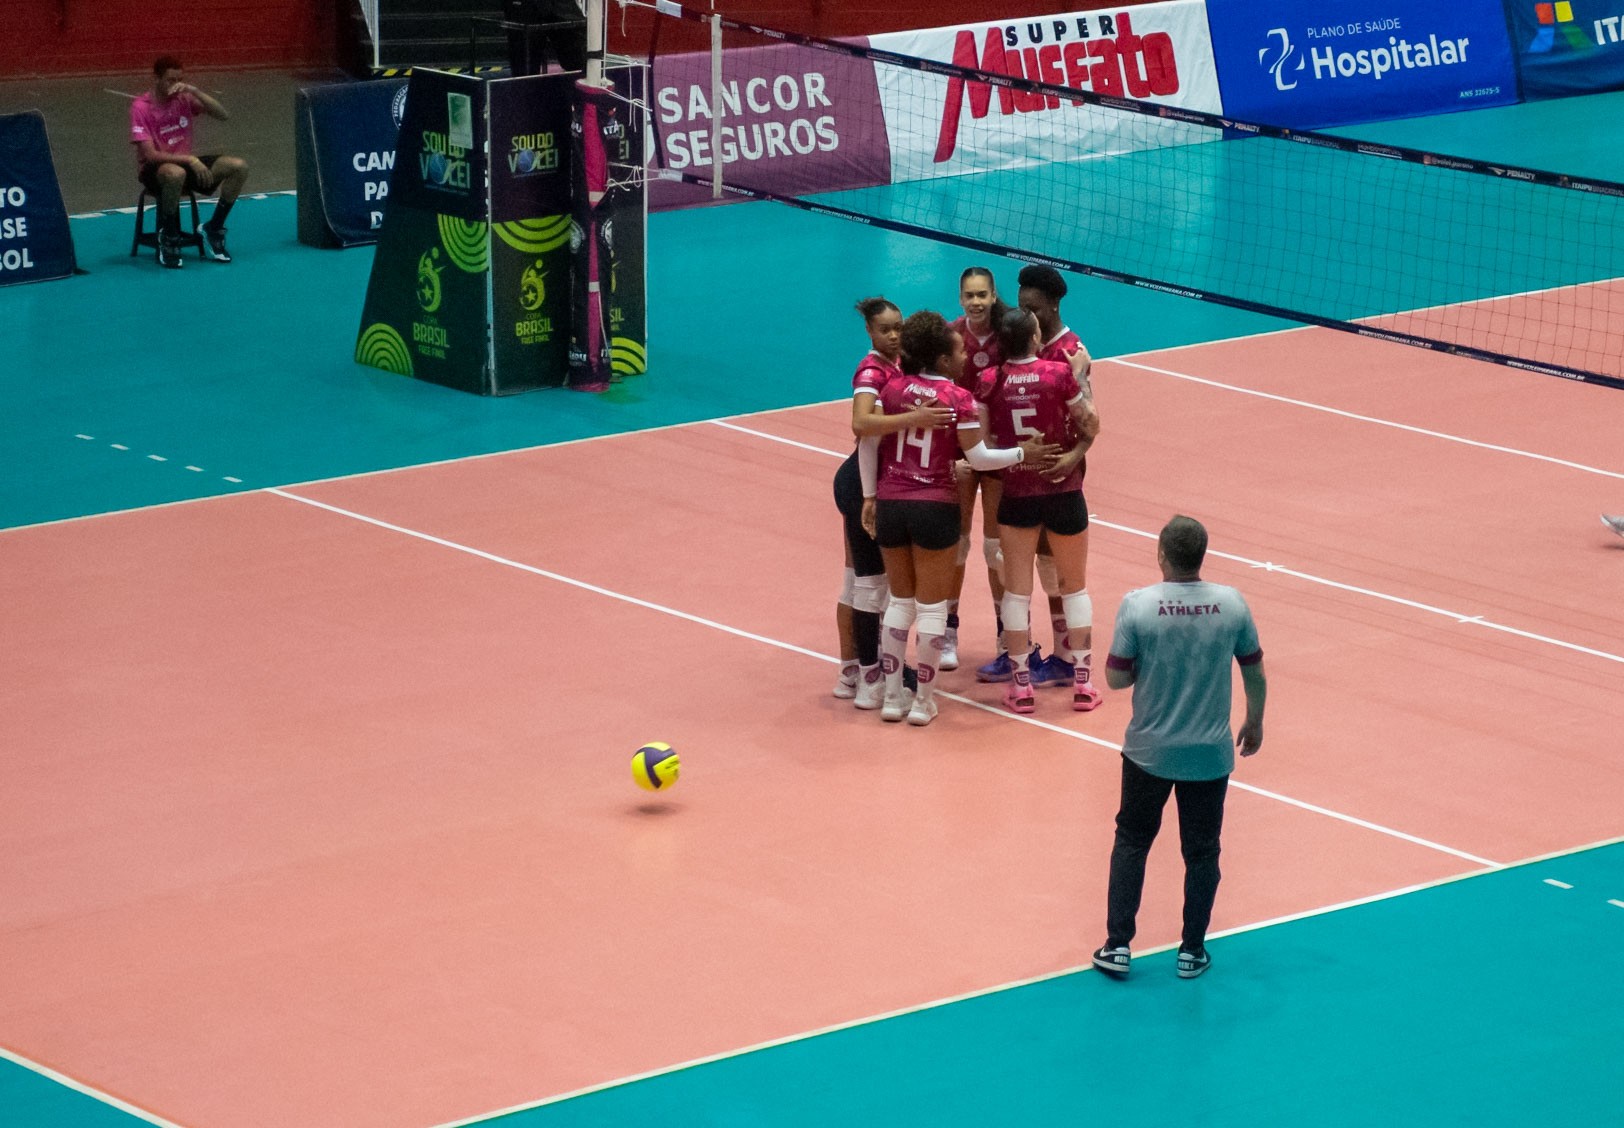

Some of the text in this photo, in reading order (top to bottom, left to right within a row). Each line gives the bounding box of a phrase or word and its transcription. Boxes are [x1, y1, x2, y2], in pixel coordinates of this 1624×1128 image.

[1005, 15, 1115, 46] SUPER
[1307, 17, 1401, 39] PLANO DE SAÚDE
[1594, 14, 1624, 45] IT
[1310, 34, 1470, 80] Hospitalar
[657, 72, 832, 123] SANCOR
[666, 116, 839, 169] SEGUROS
[1506, 170, 1536, 181] PENALTY
[0, 217, 27, 239] SE
[413, 322, 450, 348] BRASIL
[515, 317, 554, 337] BRASIL
[1158, 604, 1221, 616] ATHLETA
